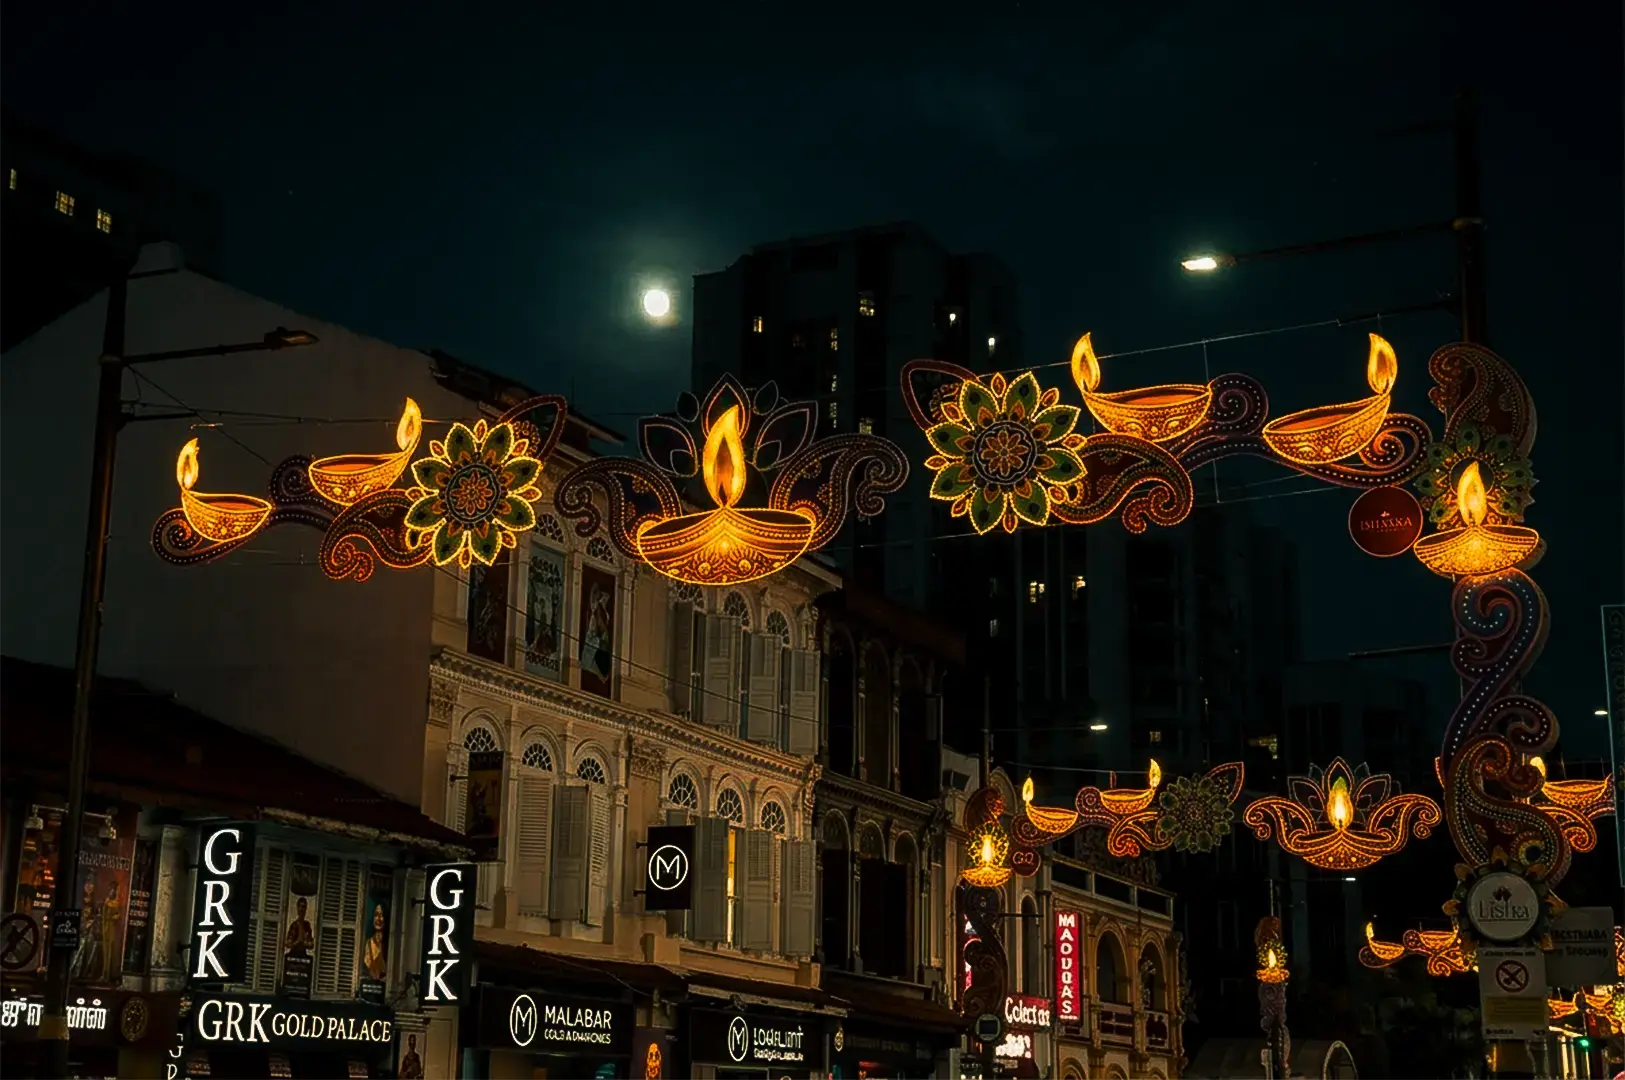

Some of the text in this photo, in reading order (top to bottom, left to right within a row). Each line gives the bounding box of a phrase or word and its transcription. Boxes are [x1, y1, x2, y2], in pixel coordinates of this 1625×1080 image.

[192, 828, 242, 978] GRK
[424, 868, 464, 1000] GRK
[198, 999, 392, 1043] GRK GOLD PALACE
[544, 1004, 612, 1030] MALABAR
